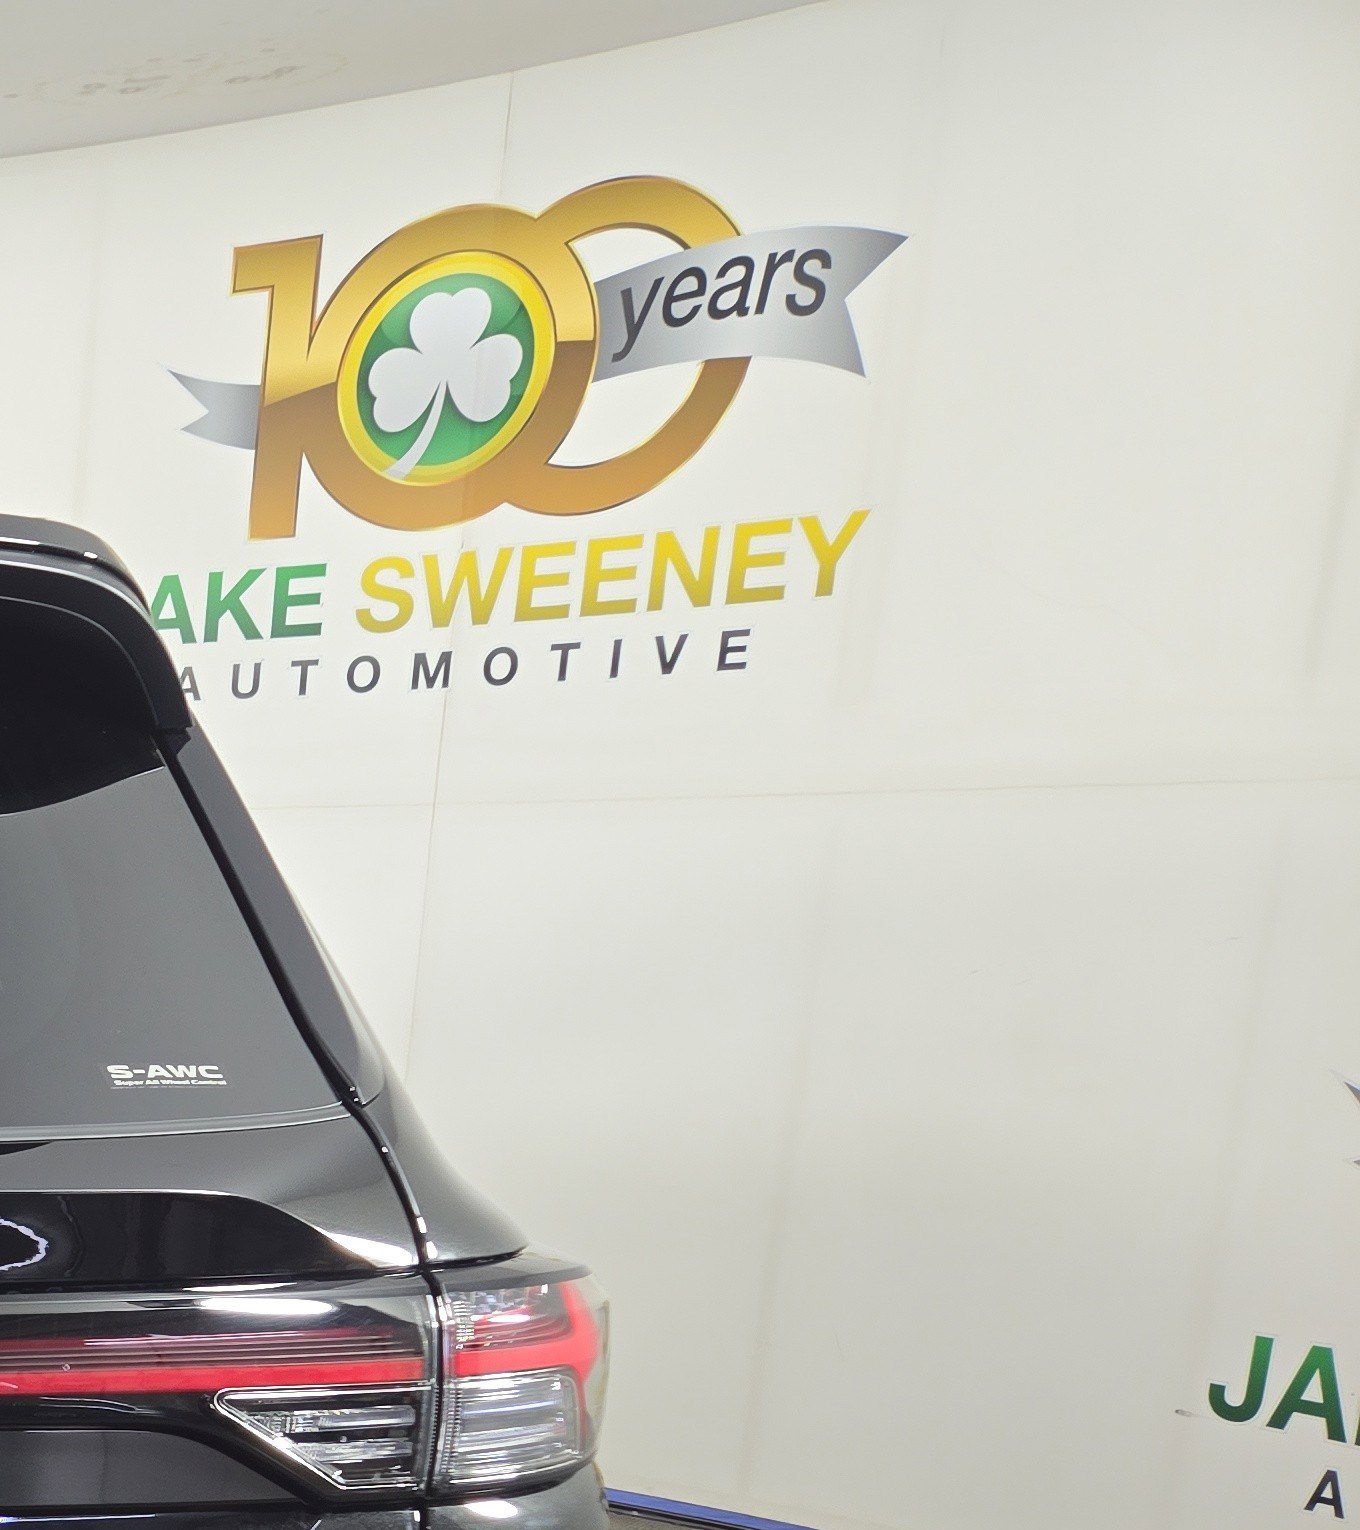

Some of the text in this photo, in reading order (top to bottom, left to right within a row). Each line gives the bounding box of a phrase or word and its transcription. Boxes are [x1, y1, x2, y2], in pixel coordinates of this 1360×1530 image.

[611, 247, 832, 363] years
[355, 510, 872, 633] SWEENEY
[180, 628, 752, 701] AUTOMOTIVE
[106, 1064, 224, 1079] S-AWC
[1207, 1335, 1360, 1447] JA
